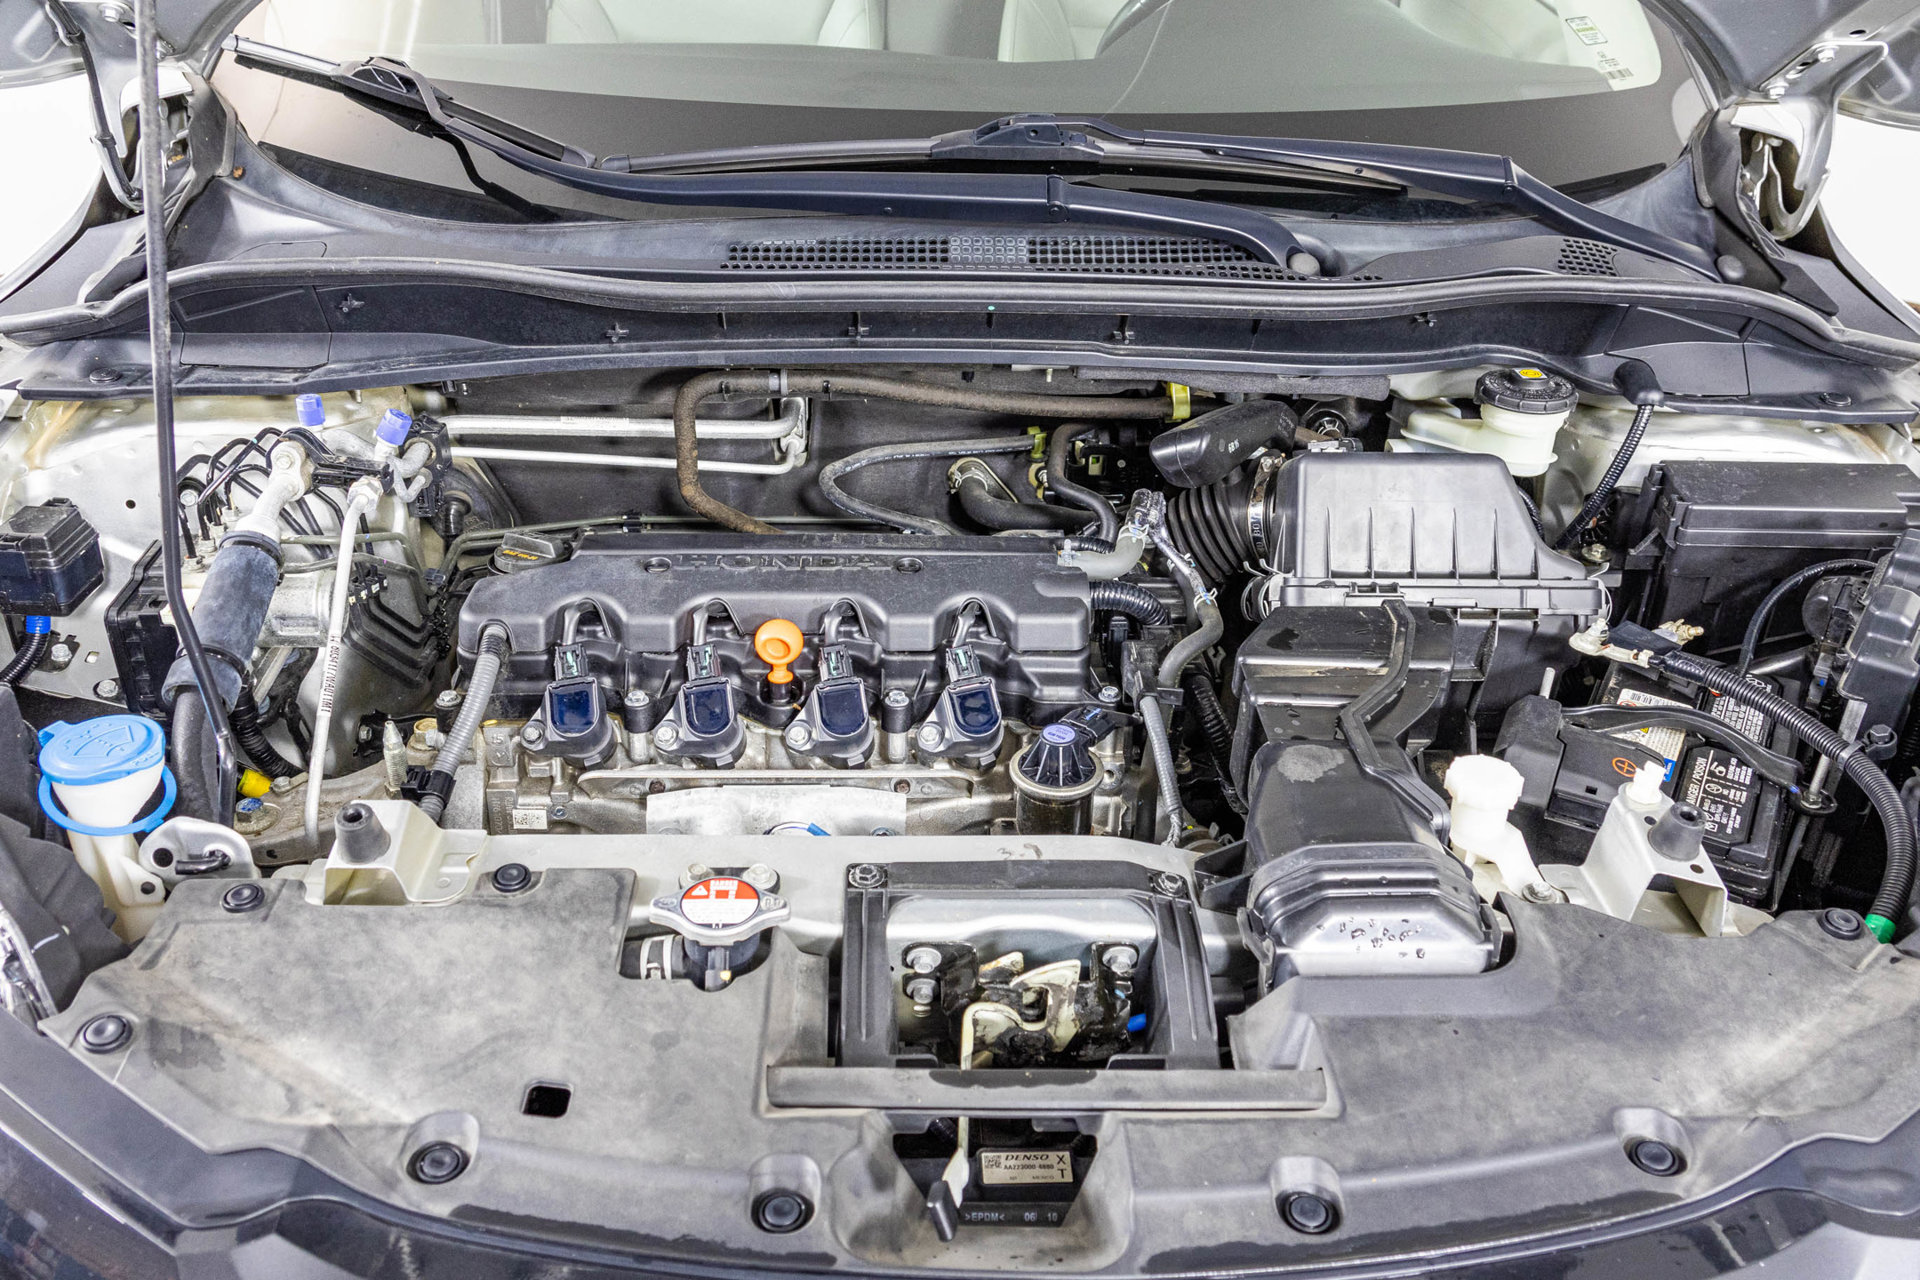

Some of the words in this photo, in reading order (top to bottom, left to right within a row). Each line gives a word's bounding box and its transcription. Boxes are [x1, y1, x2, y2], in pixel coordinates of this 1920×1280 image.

[1692, 756, 1708, 780] POISON
[1005, 1153, 1049, 1161] DENSO
[1056, 1154, 1067, 1165] X
[1057, 1168, 1067, 1179] T
[965, 1212, 1005, 1221] >EPDM<
